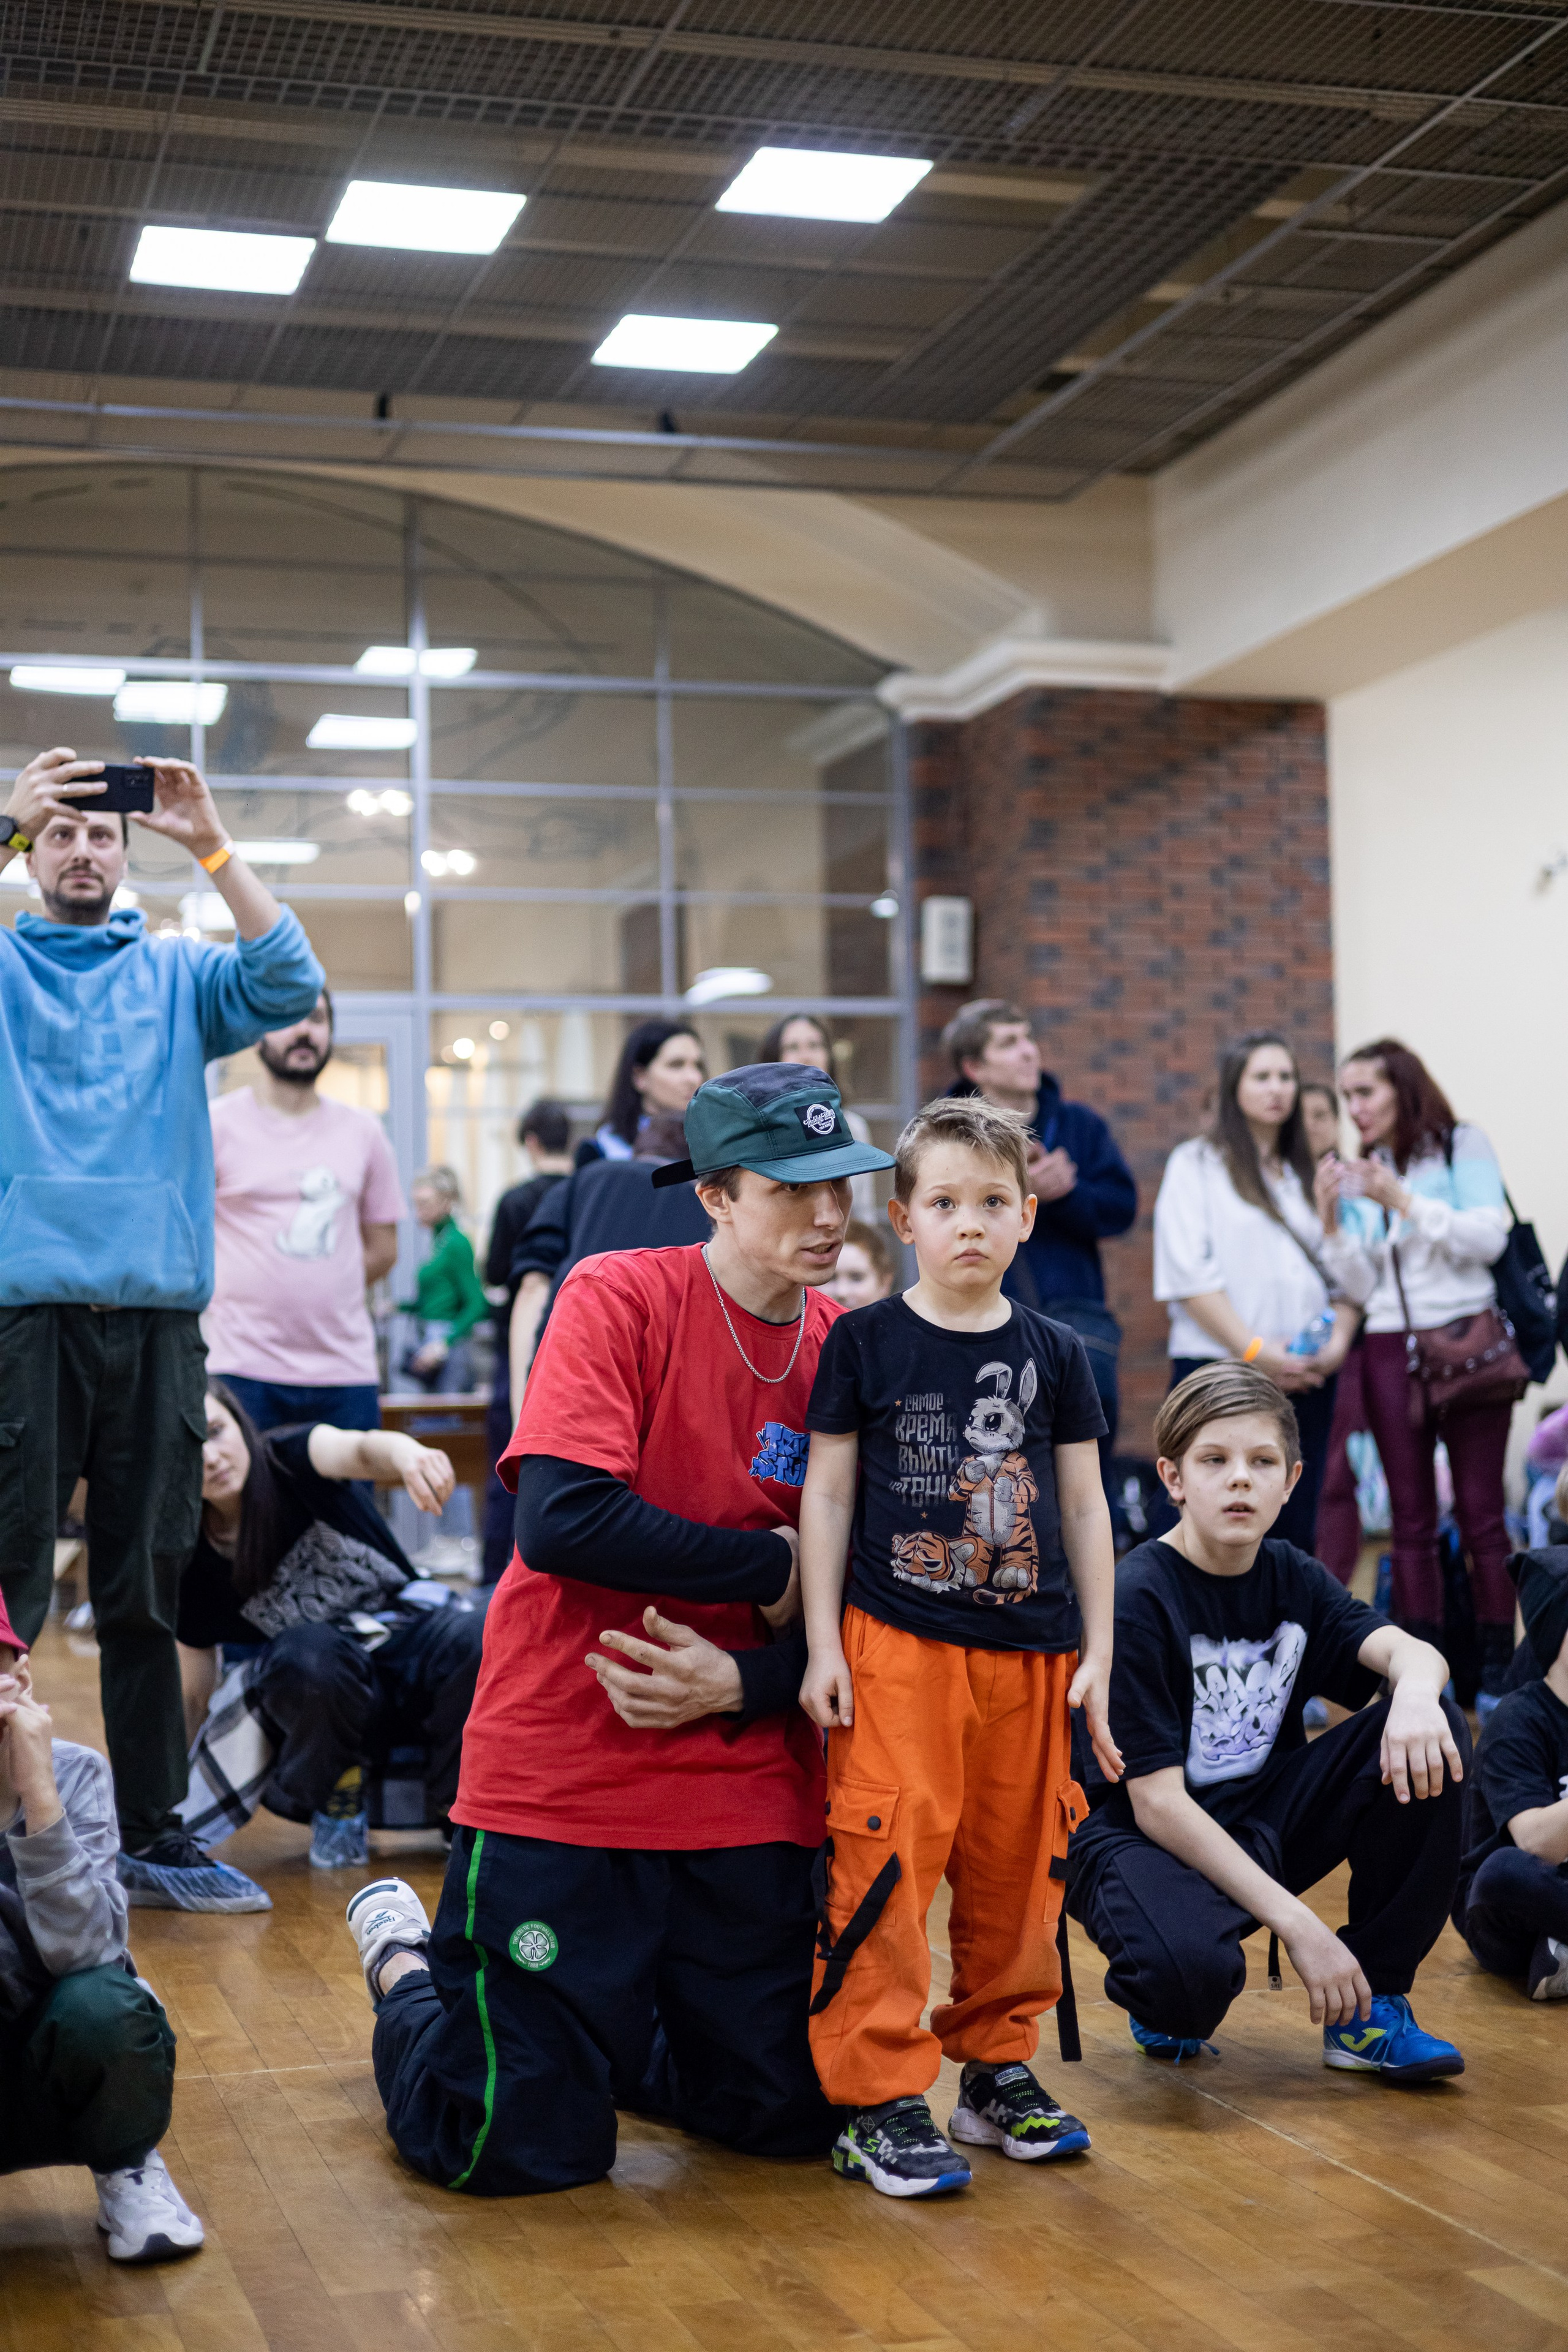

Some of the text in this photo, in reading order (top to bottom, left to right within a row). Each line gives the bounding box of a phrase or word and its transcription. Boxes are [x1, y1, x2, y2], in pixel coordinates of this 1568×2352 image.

[895, 1412, 957, 1442] ВРЕМЯ
[516, 1924, 530, 1936] CELTIC
[530, 1924, 551, 1937] FOOTBALL
